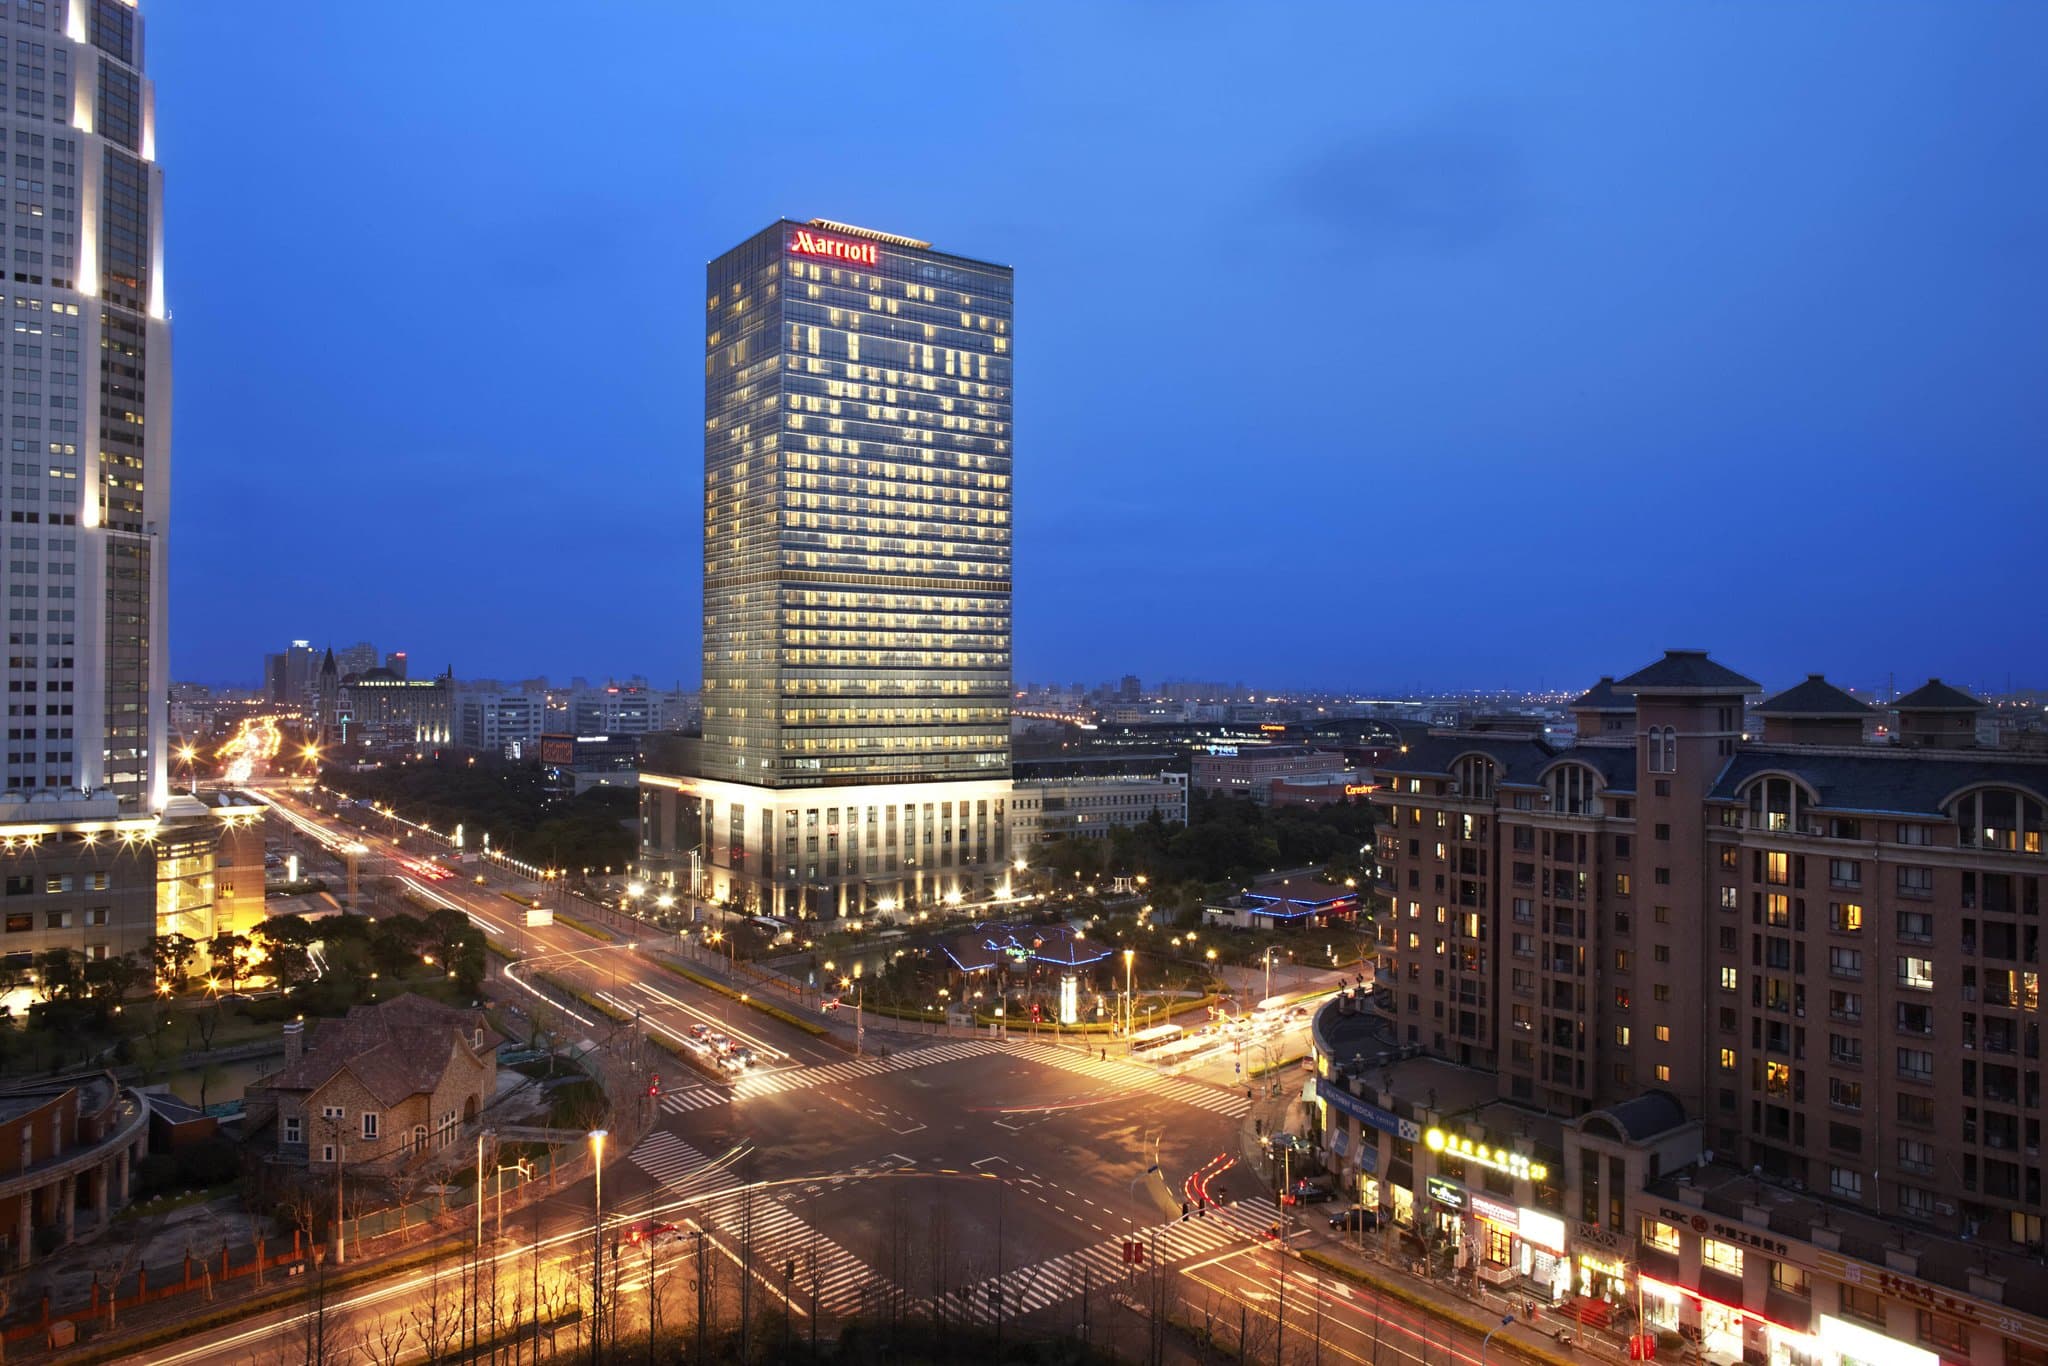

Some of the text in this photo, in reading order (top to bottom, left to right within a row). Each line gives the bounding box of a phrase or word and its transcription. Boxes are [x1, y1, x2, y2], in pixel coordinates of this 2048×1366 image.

[791, 231, 875, 264] Marriott
[1351, 1103, 1375, 1120] MEDICAL
[1659, 1207, 1688, 1224] ICBC
[1713, 1223, 1788, 1256] 中国工商银行
